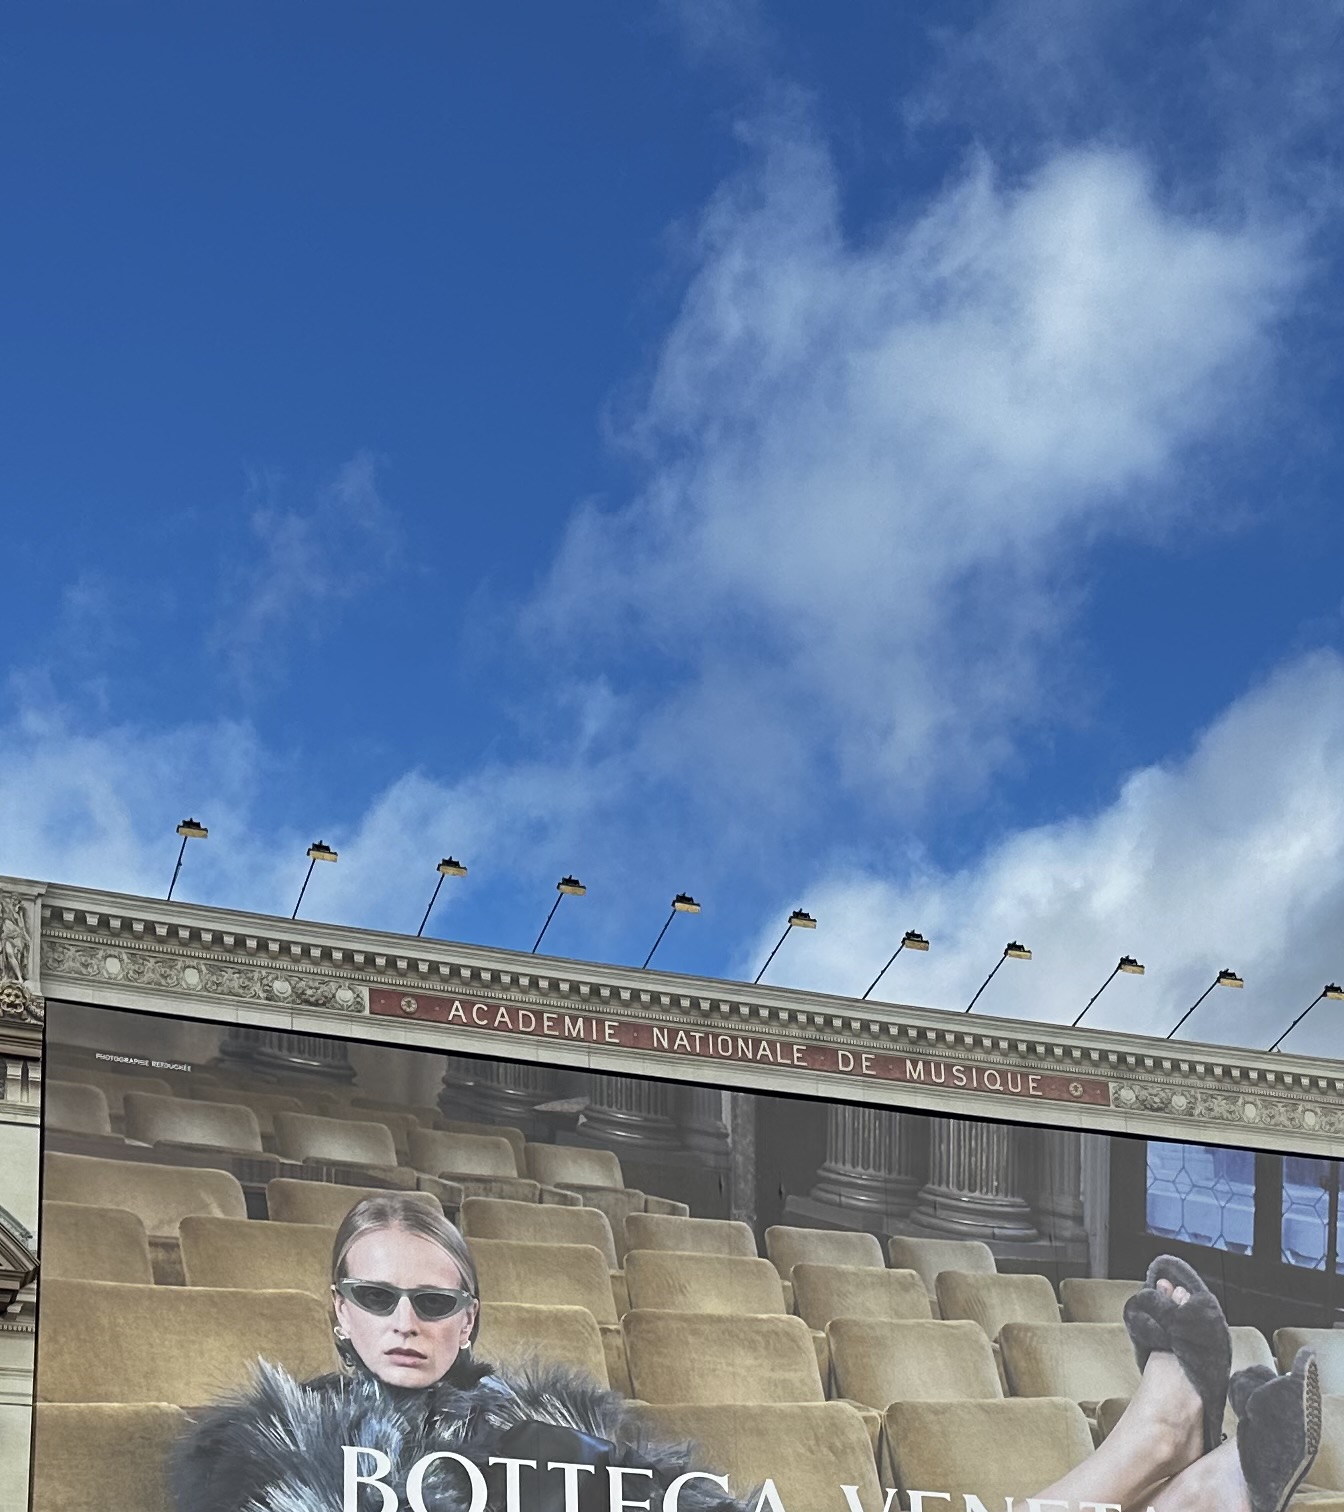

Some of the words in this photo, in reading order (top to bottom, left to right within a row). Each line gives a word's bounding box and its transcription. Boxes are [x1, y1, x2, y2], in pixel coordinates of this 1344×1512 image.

[447, 1001, 620, 1043] ACADEMIE
[653, 1027, 809, 1066] NATIONALE
[837, 1051, 877, 1075] DE
[906, 1059, 1044, 1096] MUSIQUE
